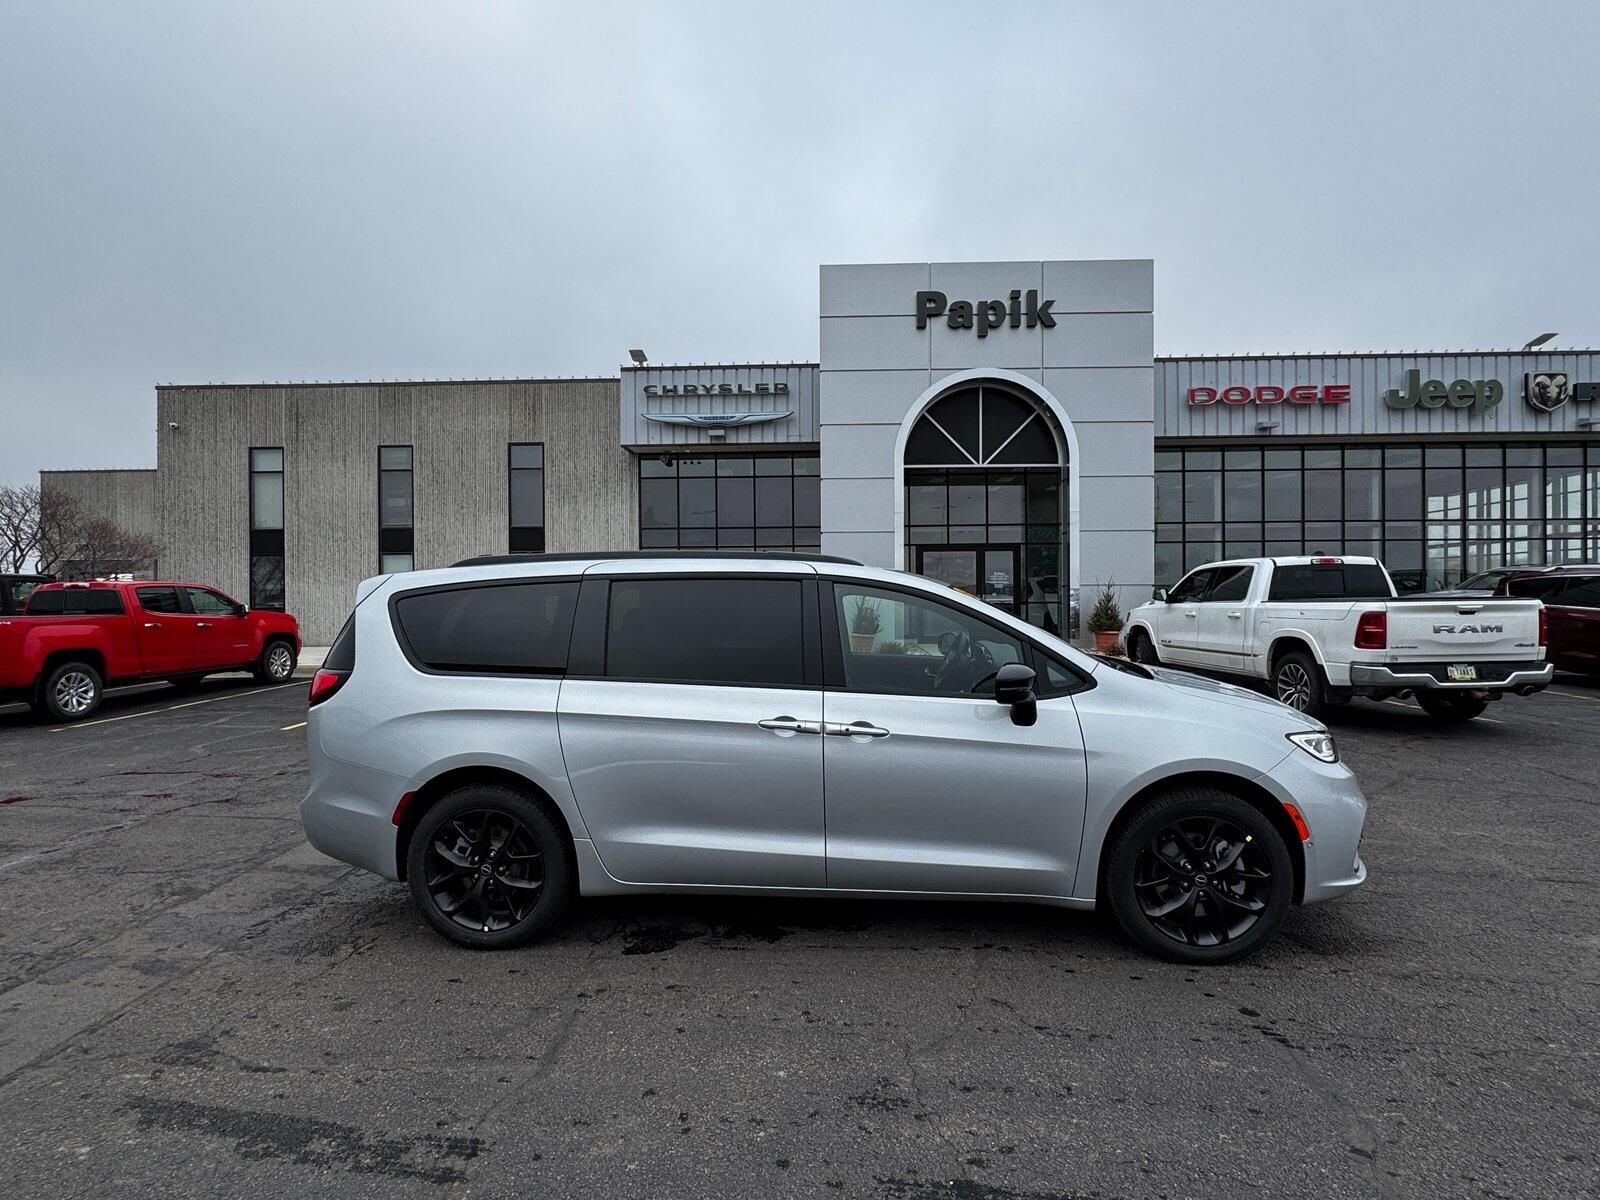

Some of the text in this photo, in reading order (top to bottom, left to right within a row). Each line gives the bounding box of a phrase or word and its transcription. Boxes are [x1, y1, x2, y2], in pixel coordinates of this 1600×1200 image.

[916, 289, 1057, 337] Papik
[643, 382, 790, 397] CHRYSLER
[1188, 384, 1351, 405] DODGE
[1384, 369, 1504, 416] Jeep
[1433, 624, 1503, 634] RAM
